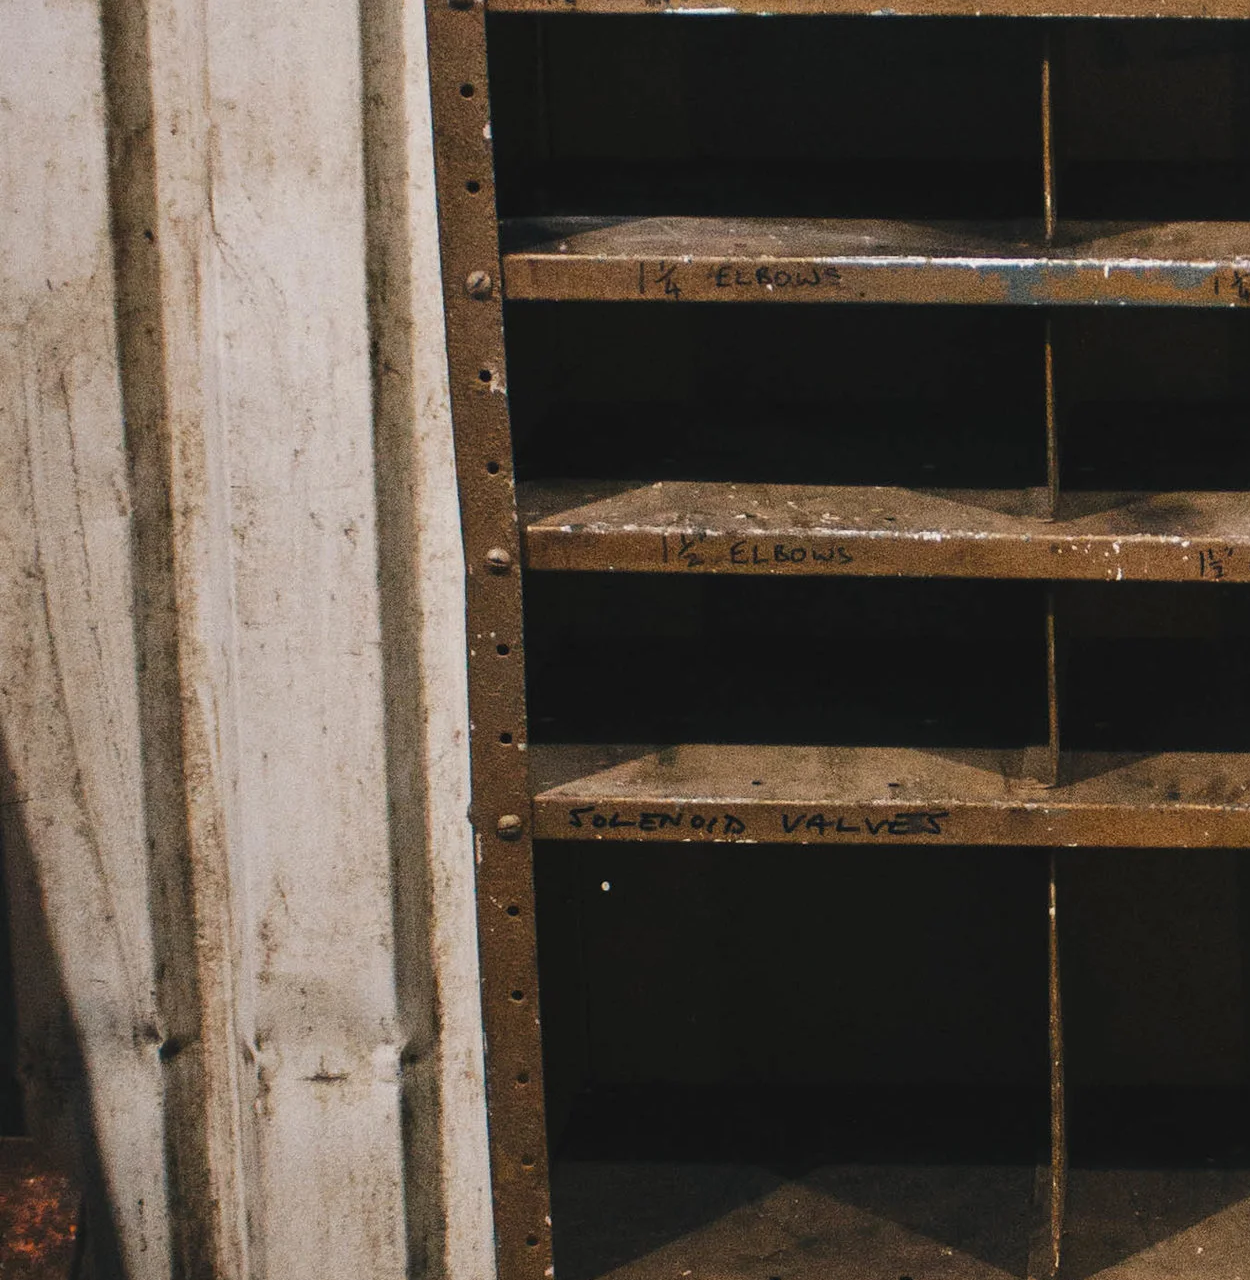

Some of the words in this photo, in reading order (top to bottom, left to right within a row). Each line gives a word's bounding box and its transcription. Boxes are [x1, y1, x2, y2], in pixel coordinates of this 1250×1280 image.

[714, 265, 842, 289] ELBOWS
[729, 540, 853, 565] ELBOWS
[568, 806, 747, 835] SOLENOID
[781, 811, 950, 836] VALVES
